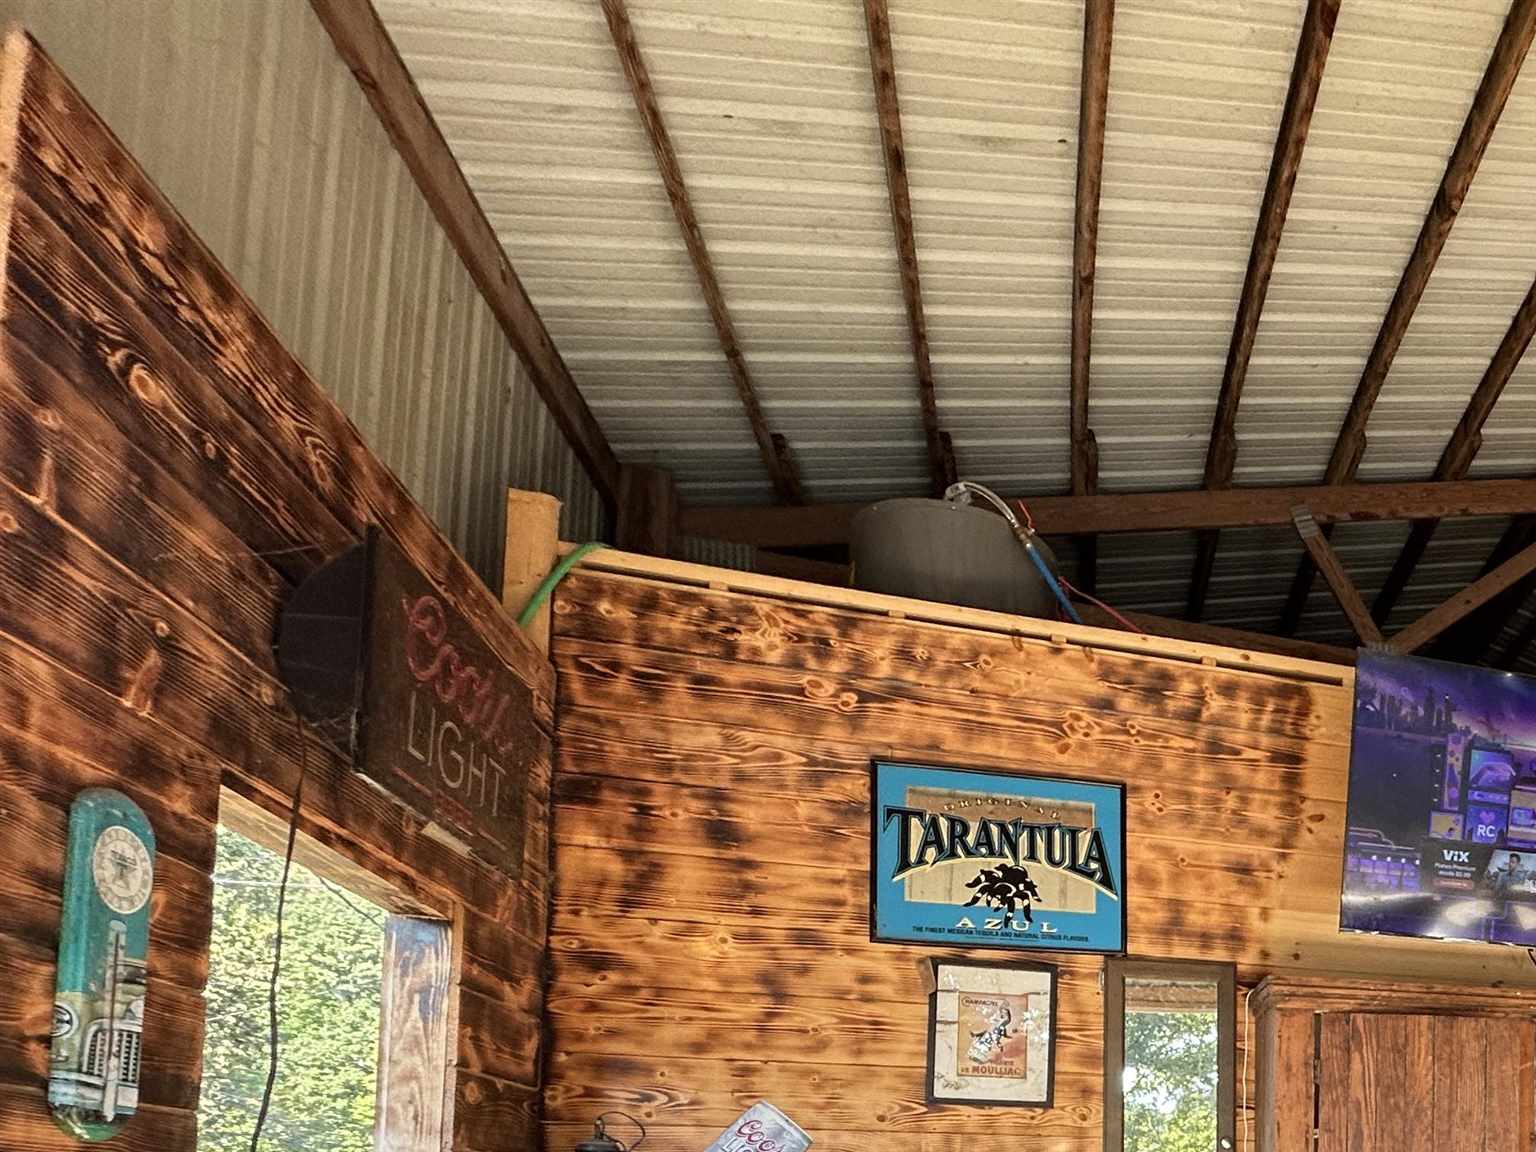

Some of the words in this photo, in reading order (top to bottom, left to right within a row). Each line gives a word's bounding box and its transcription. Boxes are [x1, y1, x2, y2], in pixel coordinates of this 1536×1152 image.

[407, 690, 508, 818] LIGHT
[882, 804, 1119, 899] TARANTULA
[1476, 824, 1496, 837] RC
[955, 916, 1058, 934] AZUL
